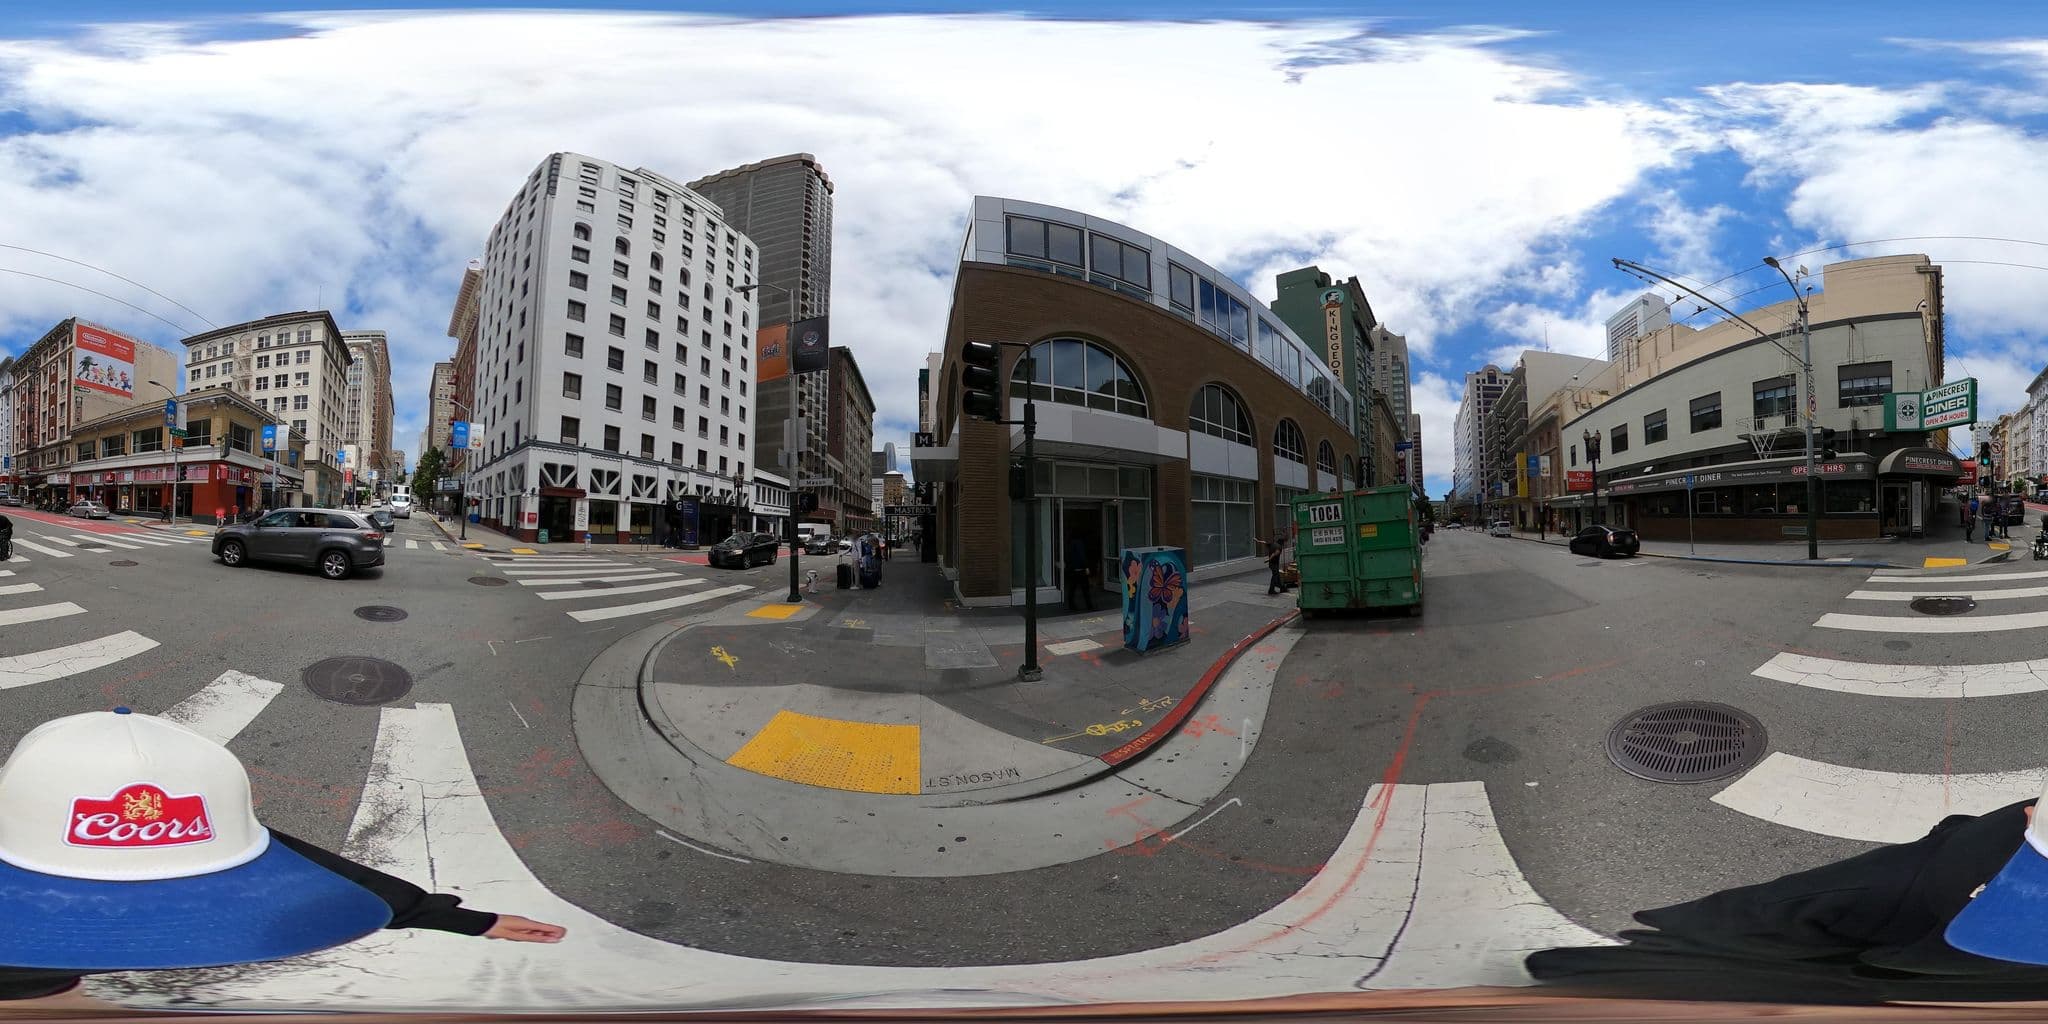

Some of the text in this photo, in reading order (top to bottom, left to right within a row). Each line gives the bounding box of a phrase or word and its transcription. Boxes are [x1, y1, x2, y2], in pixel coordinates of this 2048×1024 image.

[1329, 310, 1340, 381] KING GEOR
[1932, 382, 1969, 400] PINECREST
[1926, 396, 1967, 415] DINER
[1926, 411, 1967, 426] OPEN 24 HOURS
[919, 434, 929, 444] M
[1500, 417, 1508, 478] PARKING
[1827, 464, 1843, 472] HRS
[1905, 456, 1936, 465] PINECREST
[1793, 466, 1808, 474] OPE
[1665, 475, 1698, 485] PINECRT
[1700, 472, 1721, 482] DINER
[675, 501, 682, 511] G
[1311, 505, 1340, 522] TOCA
[925, 766, 1021, 788] MASON ST
[74, 812, 209, 842] Coors
